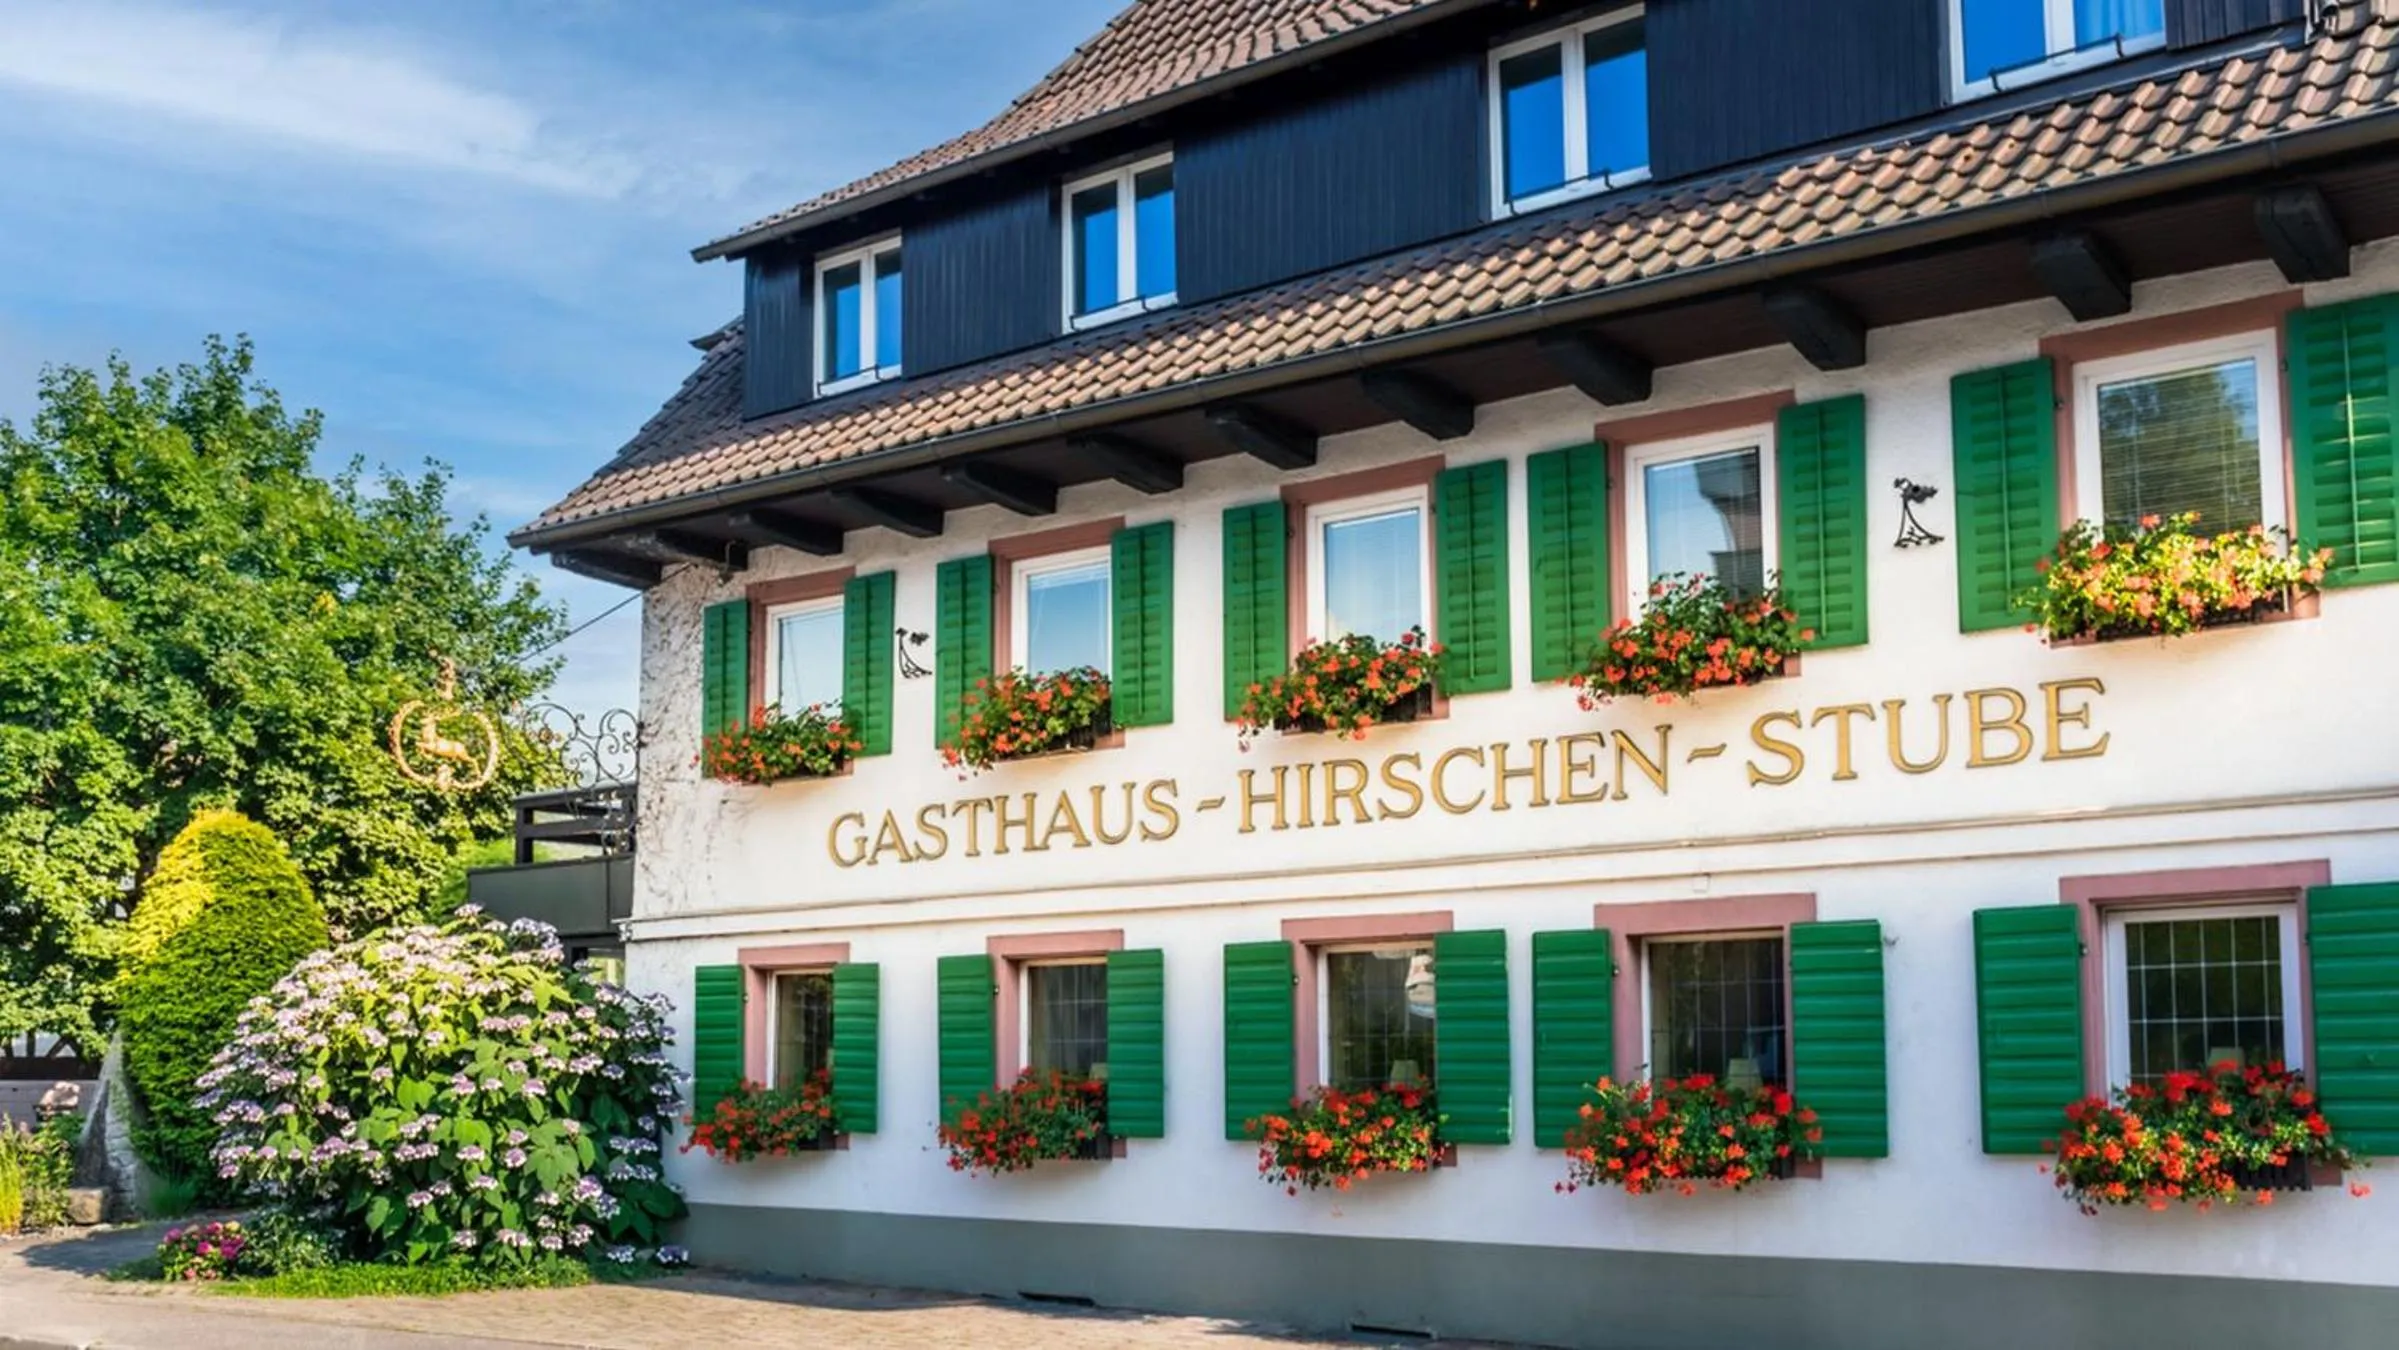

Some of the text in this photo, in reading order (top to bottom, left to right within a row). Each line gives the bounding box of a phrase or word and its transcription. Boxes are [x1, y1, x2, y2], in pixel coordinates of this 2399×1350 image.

[828, 779, 1180, 868] GASTHAUS
[1237, 722, 1675, 835] HIRSCHEN
[1747, 676, 2111, 788] STUBE
